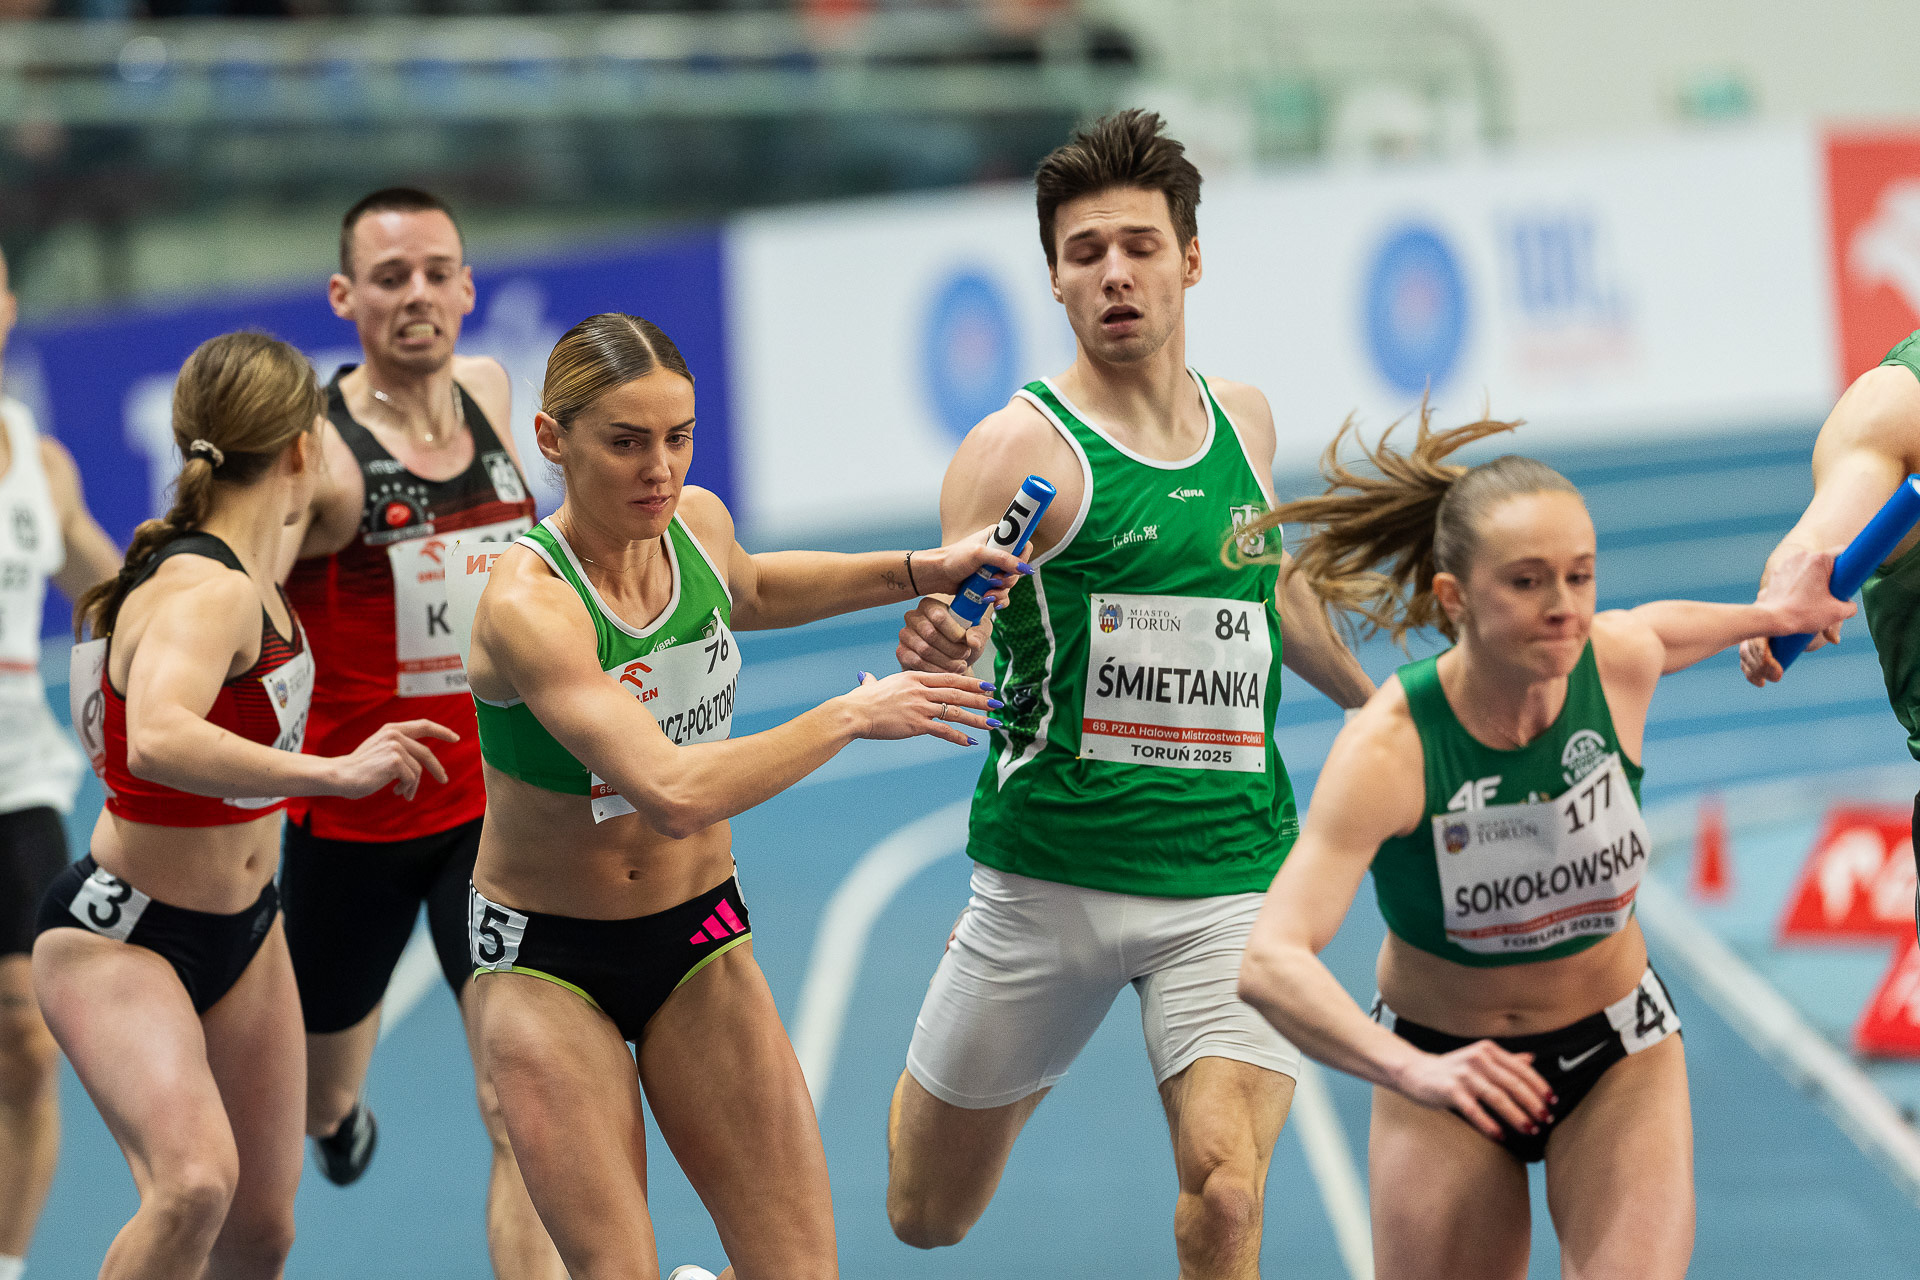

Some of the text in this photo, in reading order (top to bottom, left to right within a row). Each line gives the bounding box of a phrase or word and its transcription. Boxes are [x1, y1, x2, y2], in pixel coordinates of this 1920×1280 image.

[993, 499, 1031, 546] 5
[1127, 616, 1181, 632] TORUŃ
[1130, 609, 1170, 618] MIASTO
[1215, 608, 1251, 642] 84
[704, 627, 729, 675] 76
[1096, 656, 1260, 709] ŚMIETANKA
[1092, 721, 1262, 745] 69. PZLA Halowe Mistrzostwa Polski
[1131, 744, 1232, 763] TORUŃ 2025
[1564, 771, 1611, 835] 177
[1455, 829, 1645, 918] SOKOŁOWSKA
[87, 877, 133, 928] 3
[478, 904, 506, 964] 5
[1635, 983, 1667, 1039] 4
